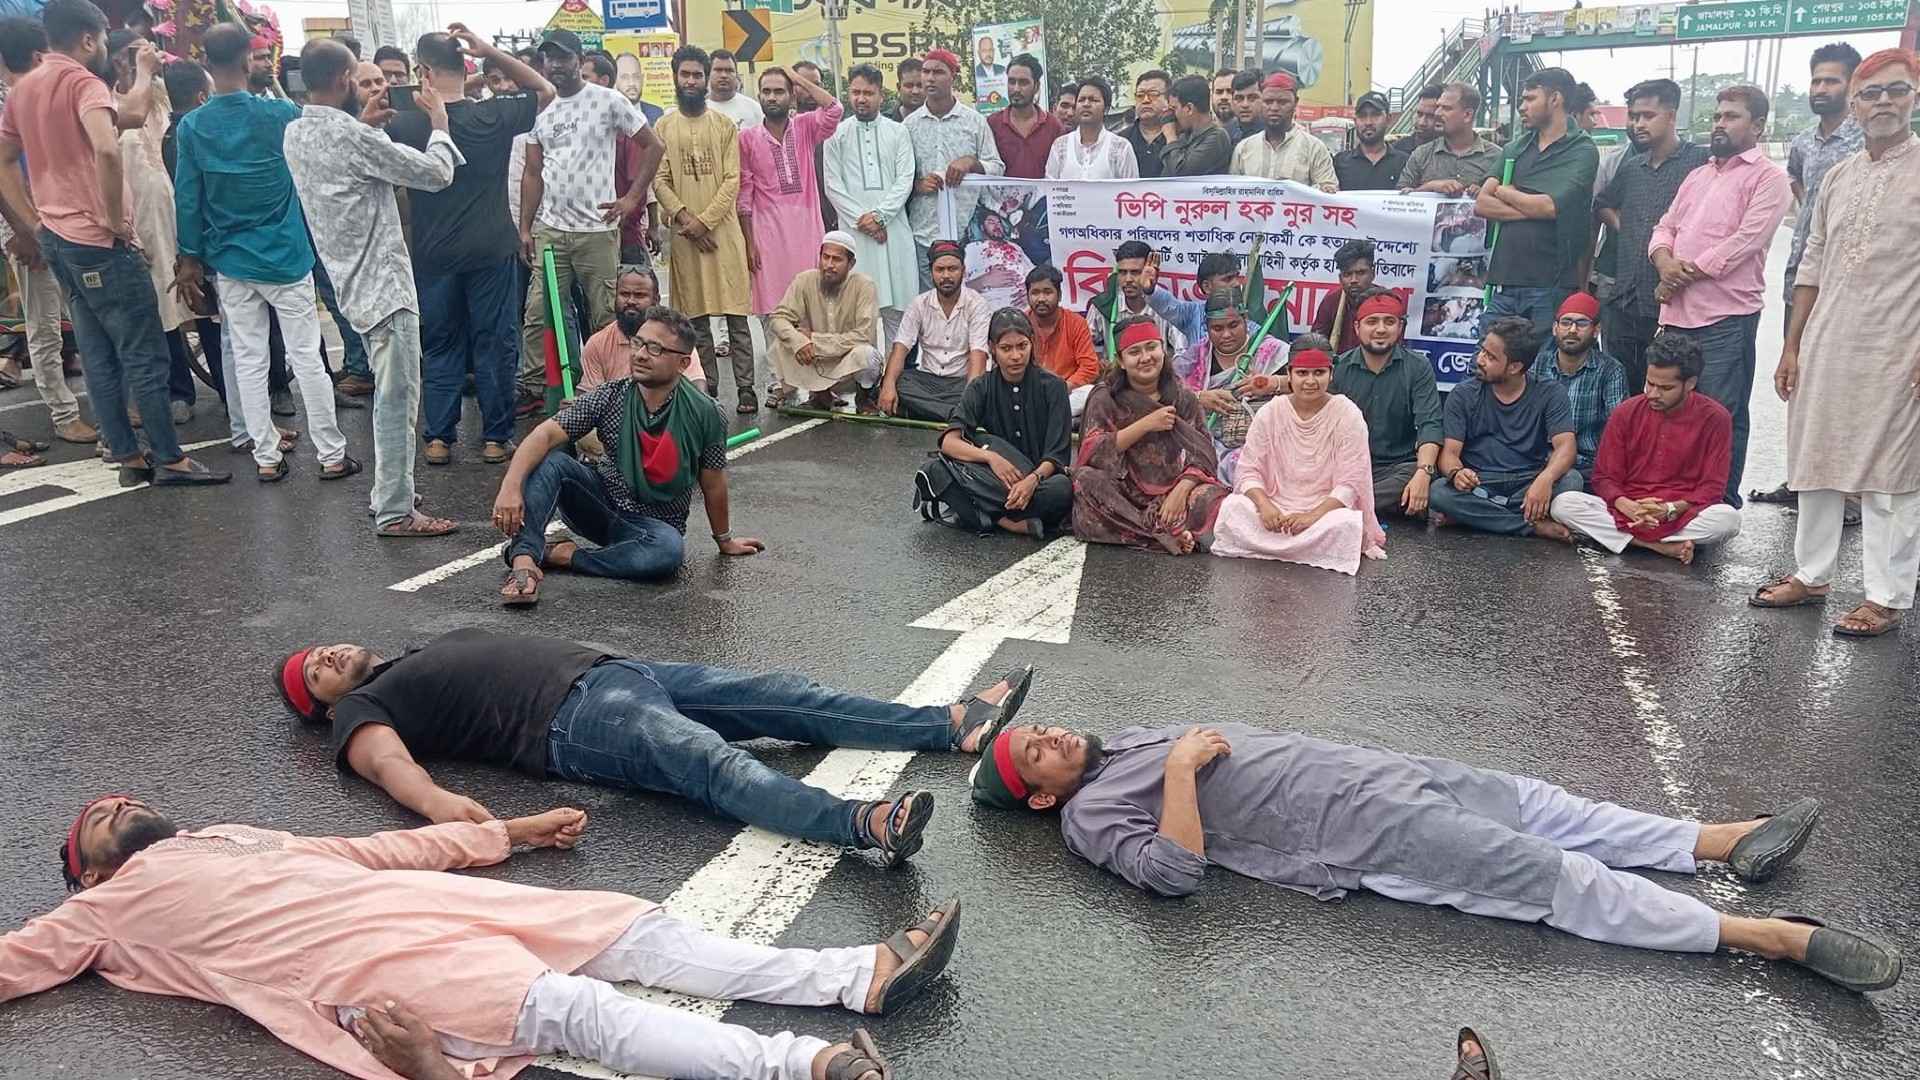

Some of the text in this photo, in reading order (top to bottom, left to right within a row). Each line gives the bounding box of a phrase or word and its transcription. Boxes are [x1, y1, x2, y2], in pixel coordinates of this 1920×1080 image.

[1811, 14, 1858, 25] SHERPUR
[1867, 13, 1884, 22] 105
[1696, 22, 1741, 32] JAMALPUR
[1748, 20, 1758, 29] 91
[1115, 192, 1358, 230] ভিপি নুরুল হক নুর সহ
[1059, 224, 1122, 240] গণঅধিকার
[1127, 225, 1180, 242] পরিষদের
[1185, 226, 1234, 243] শতাধিক
[1298, 236, 1317, 248] কে
[1176, 253, 1184, 264] ও
